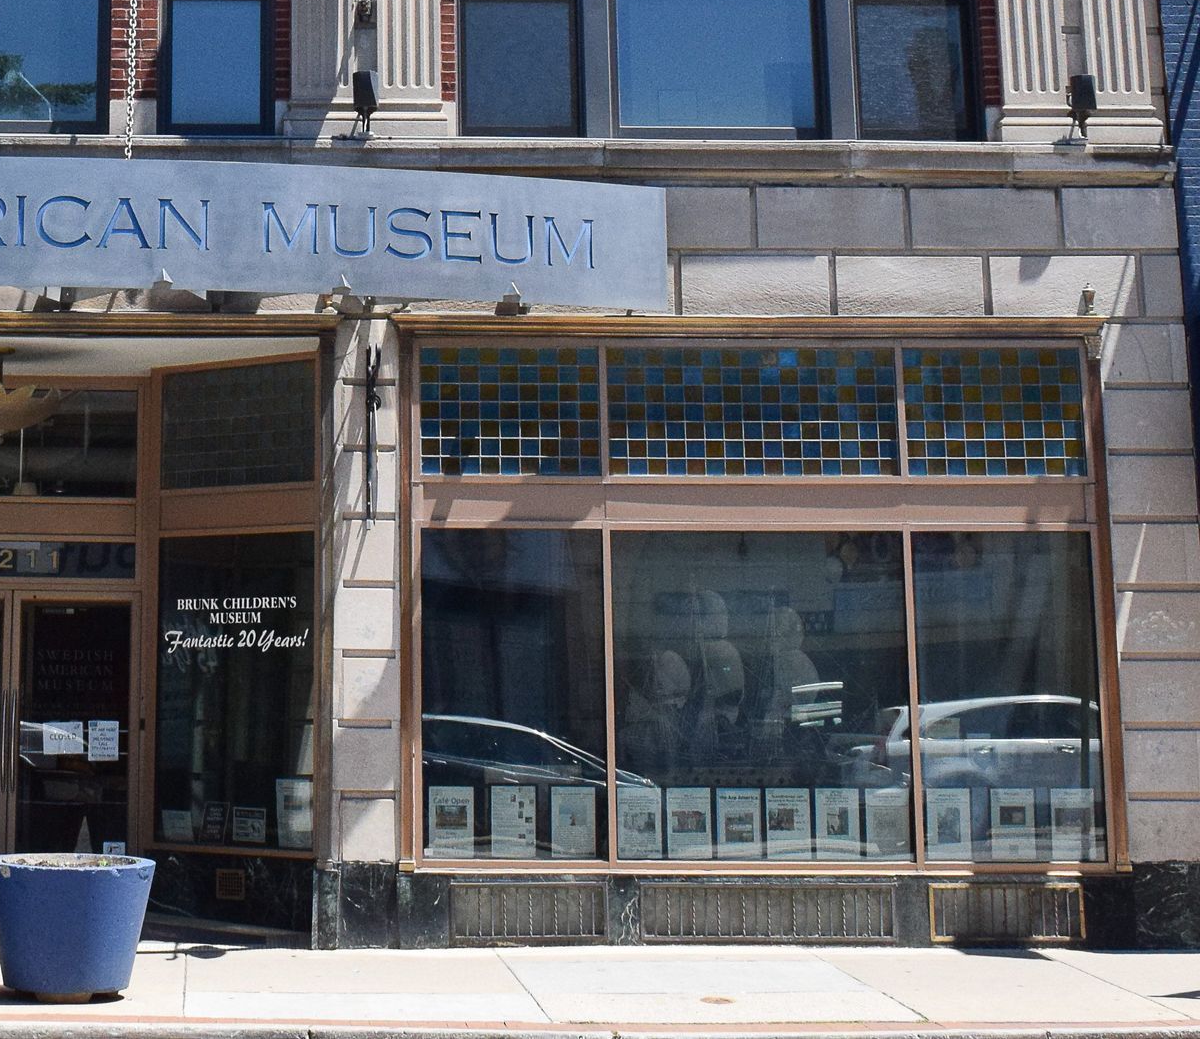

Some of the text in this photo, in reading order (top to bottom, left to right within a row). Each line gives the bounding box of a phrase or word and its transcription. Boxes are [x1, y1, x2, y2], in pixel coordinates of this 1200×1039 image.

[262, 201, 595, 269] MUSEUM
[177, 596, 297, 610] BRUNK CHILDREN'S
[209, 611, 261, 624] MUSEUM
[164, 628, 309, 653] Fantastic 20 Years!
[37, 650, 113, 661] SWEDISH
[38, 664, 113, 675] AMERICAN
[38, 679, 113, 691] MUSEUM
